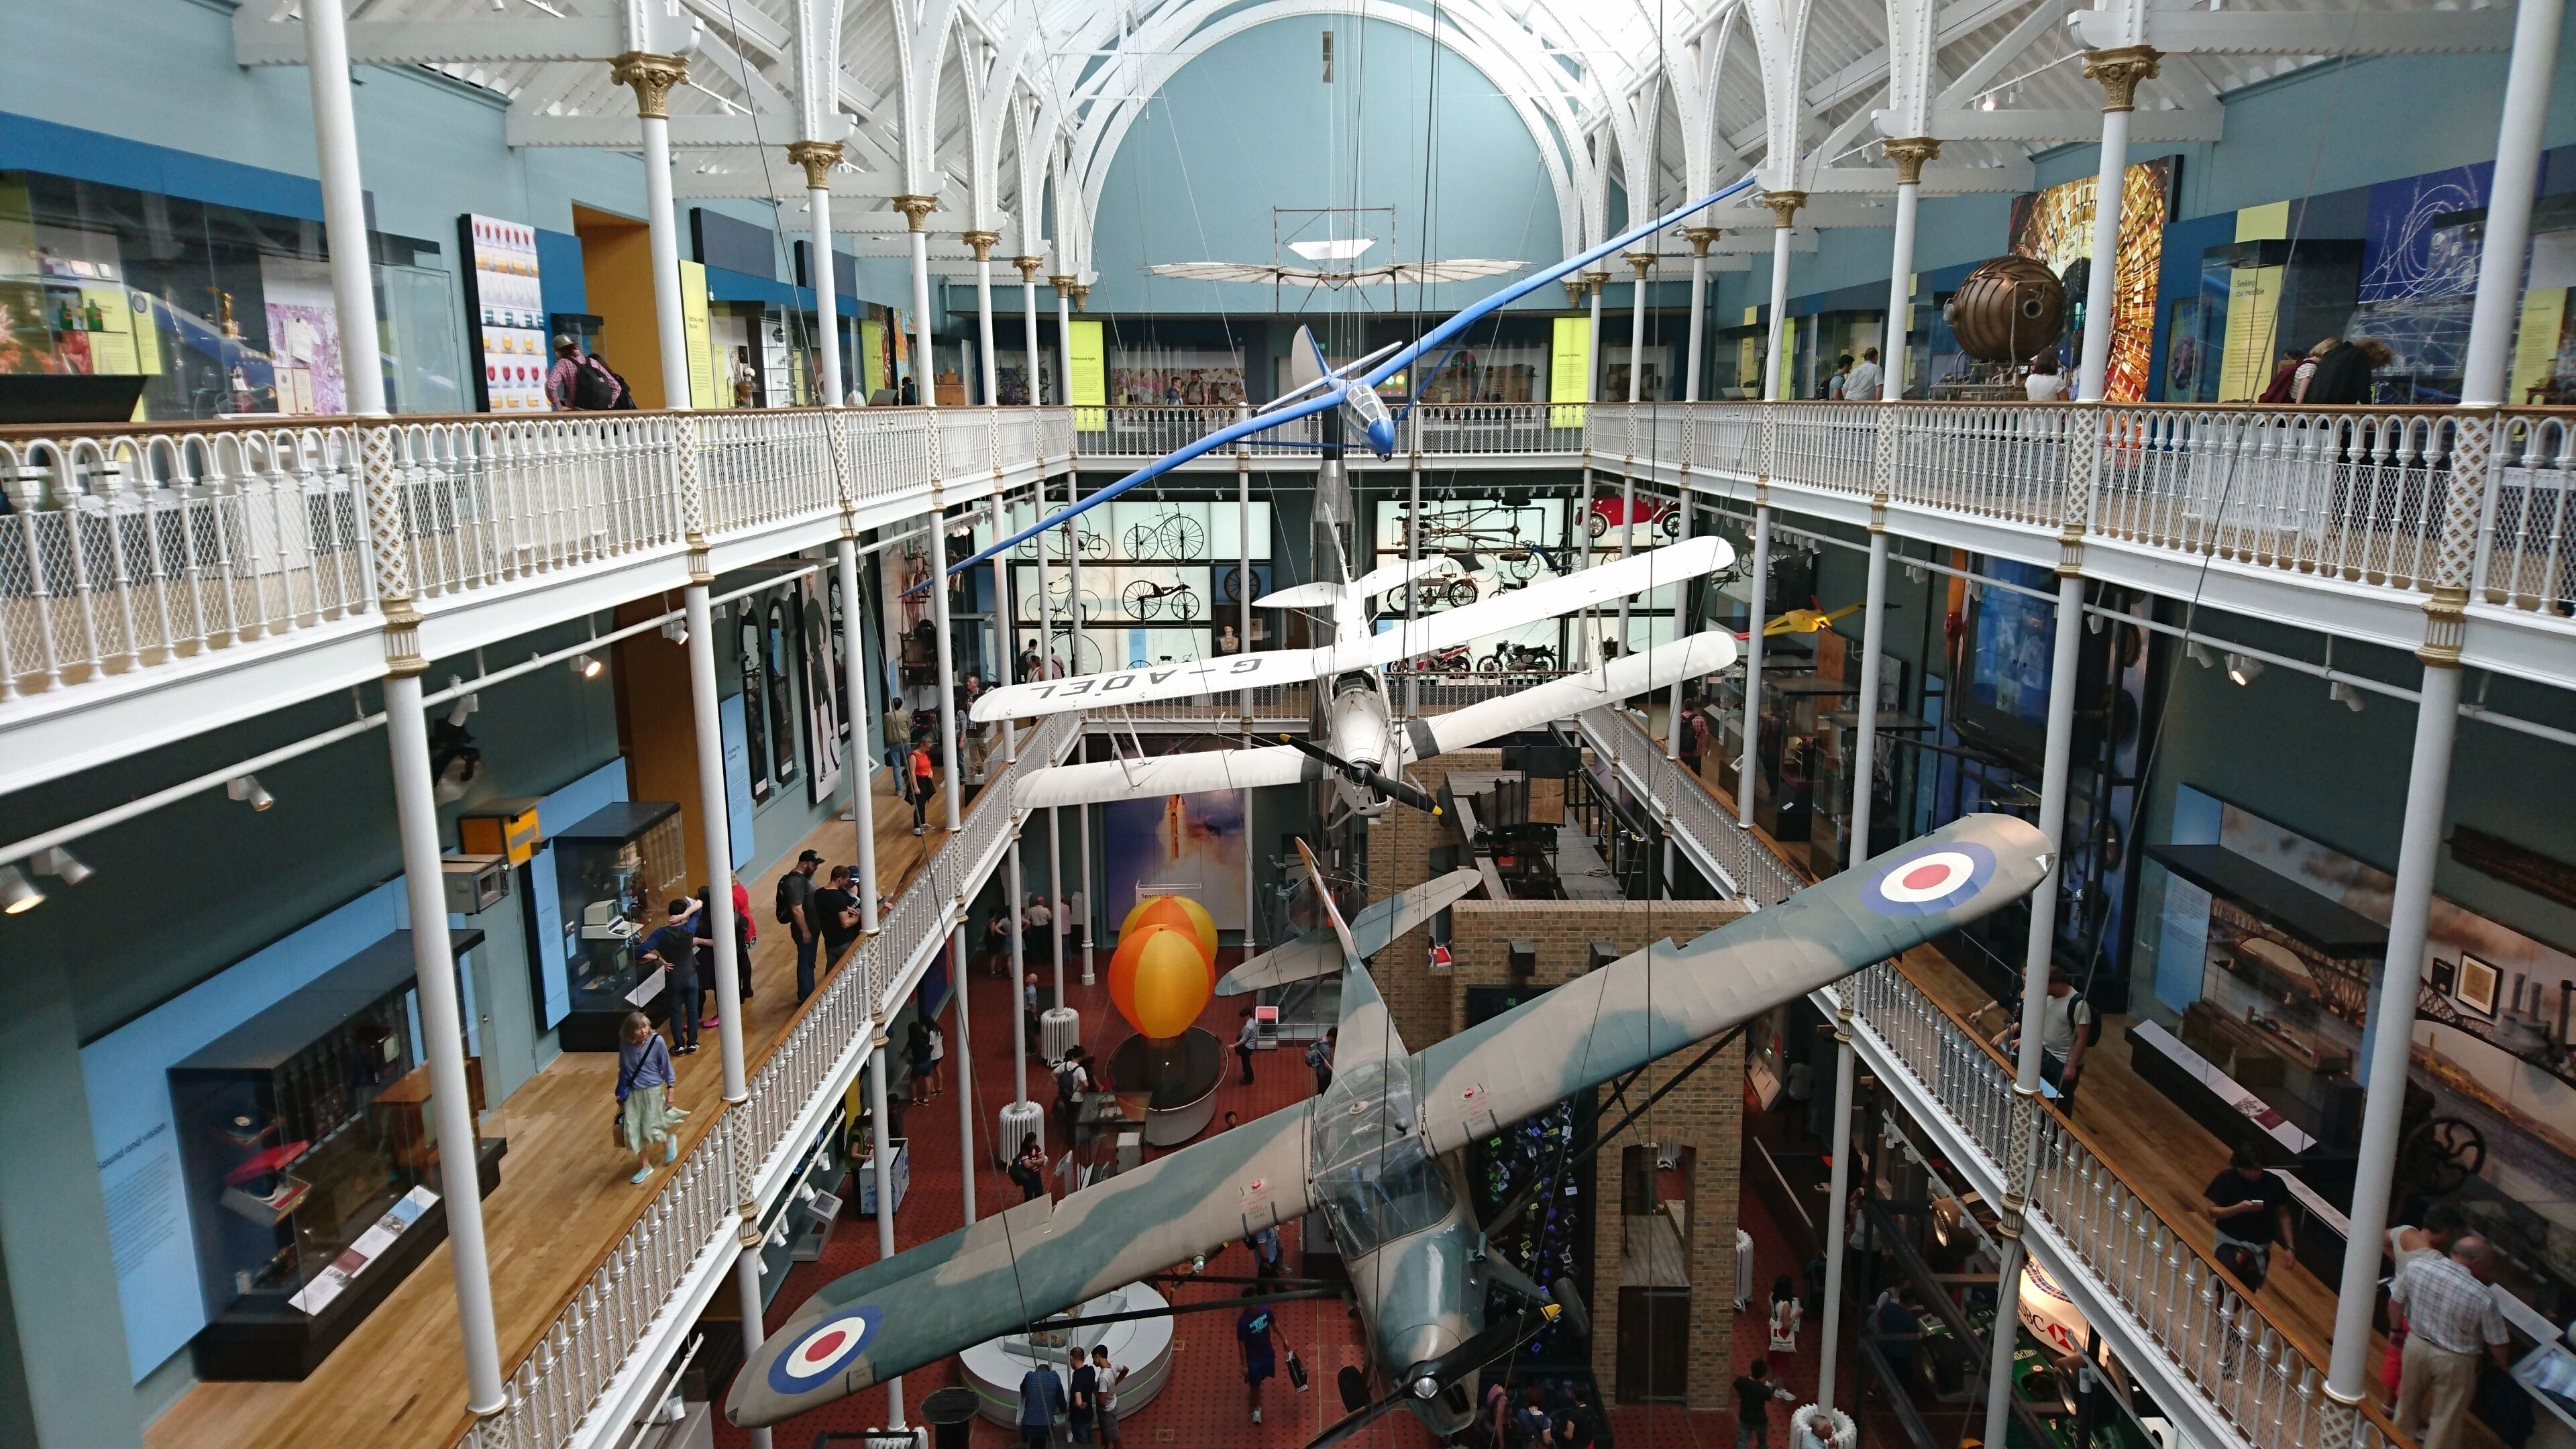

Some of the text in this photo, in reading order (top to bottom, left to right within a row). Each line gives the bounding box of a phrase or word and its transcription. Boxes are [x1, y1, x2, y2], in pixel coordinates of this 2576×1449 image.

[2237, 280, 2255, 288] Seeking
[2245, 287, 2265, 297] invisble
[97, 1122, 166, 1172] Sound and vision
[2019, 1299, 2045, 1332] SBC
[1774, 1328, 1778, 1337] I
